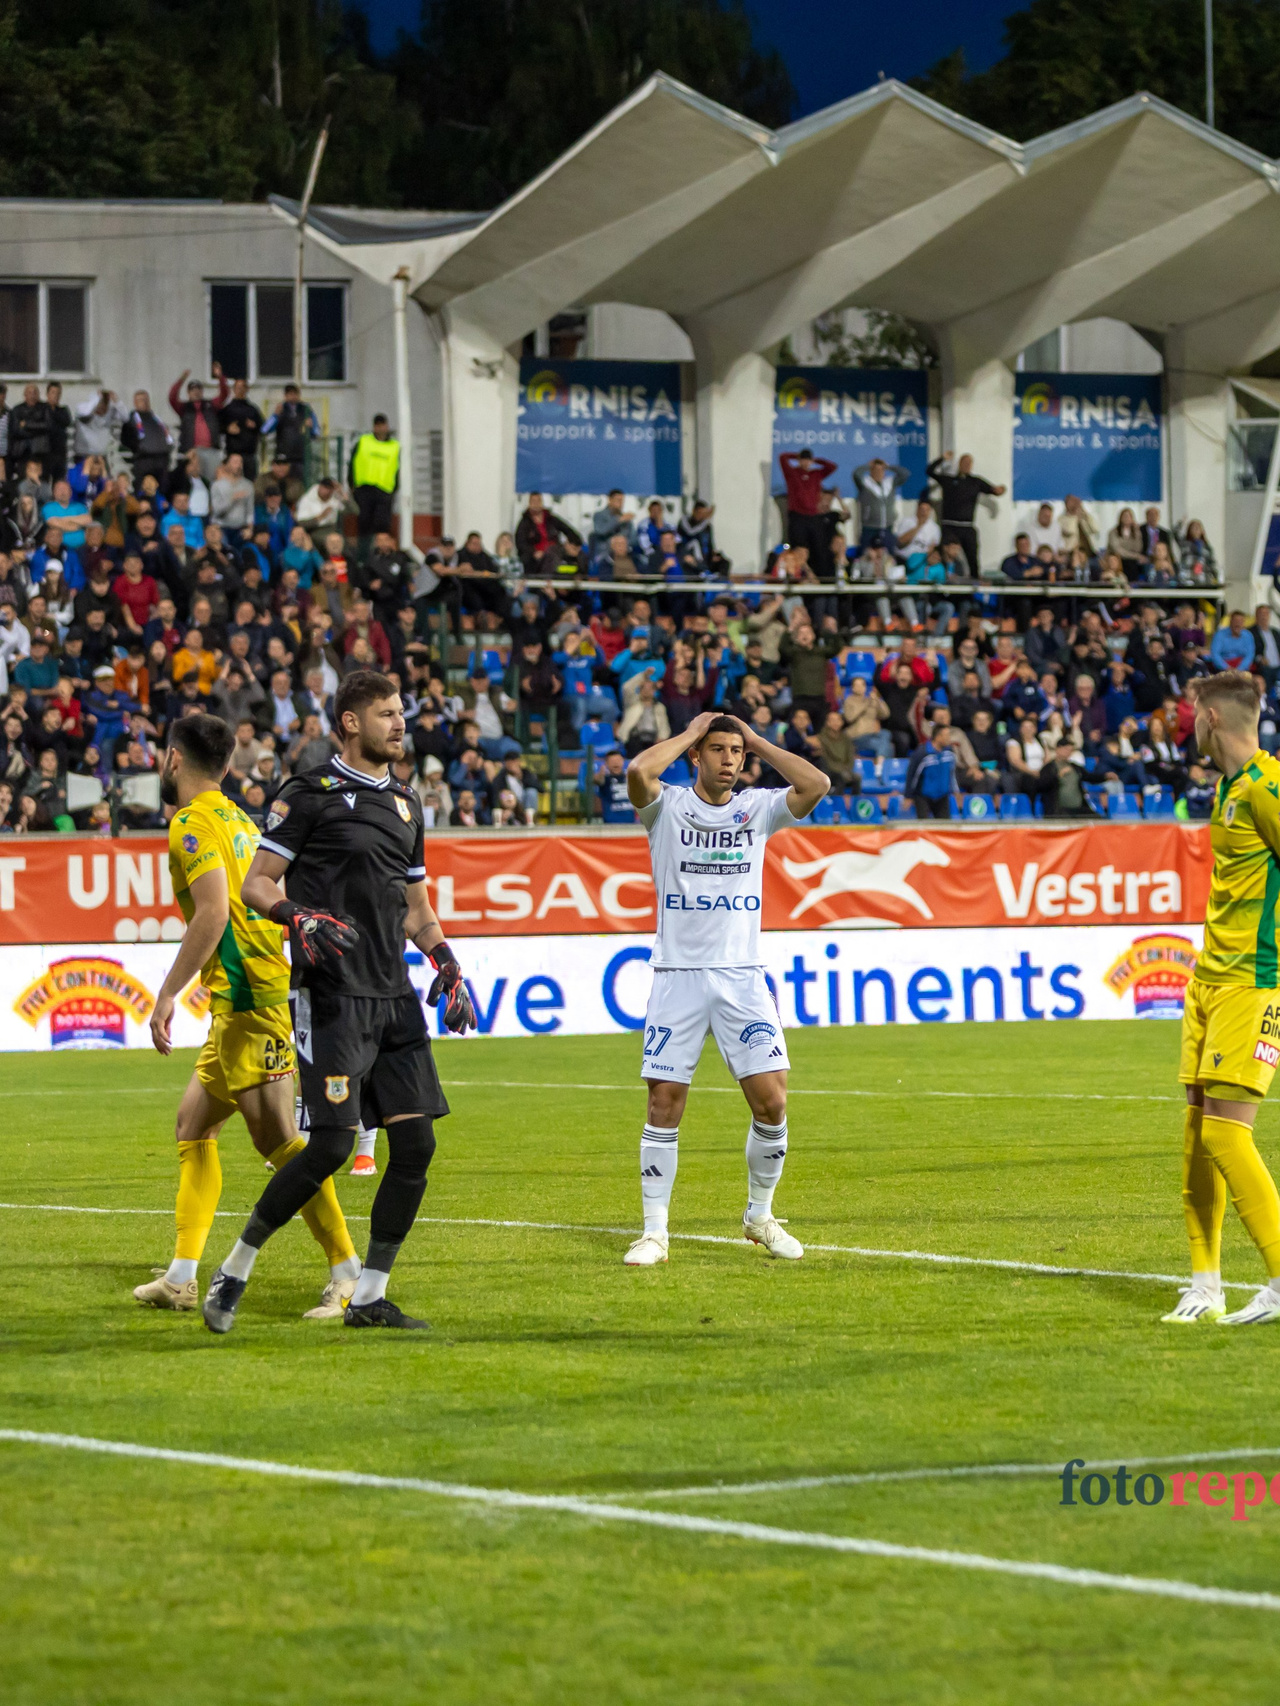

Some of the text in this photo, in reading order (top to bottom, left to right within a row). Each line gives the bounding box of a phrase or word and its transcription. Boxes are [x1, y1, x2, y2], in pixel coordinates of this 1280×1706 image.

[604, 423, 617, 441] &
[624, 426, 680, 442] sports
[854, 428, 866, 446] &
[873, 431, 926, 448] sports
[1091, 432, 1103, 450] &
[1109, 435, 1160, 451] sports
[681, 828, 756, 849] UNIBET
[721, 865, 740, 874] SPRE
[424, 871, 654, 922] LSAC
[992, 862, 1182, 918] Vestra
[665, 894, 761, 912] ELSACO
[602, 943, 1086, 1035] Ctinents
[644, 1025, 673, 1056] 27
[651, 1062, 674, 1072] Vestra
